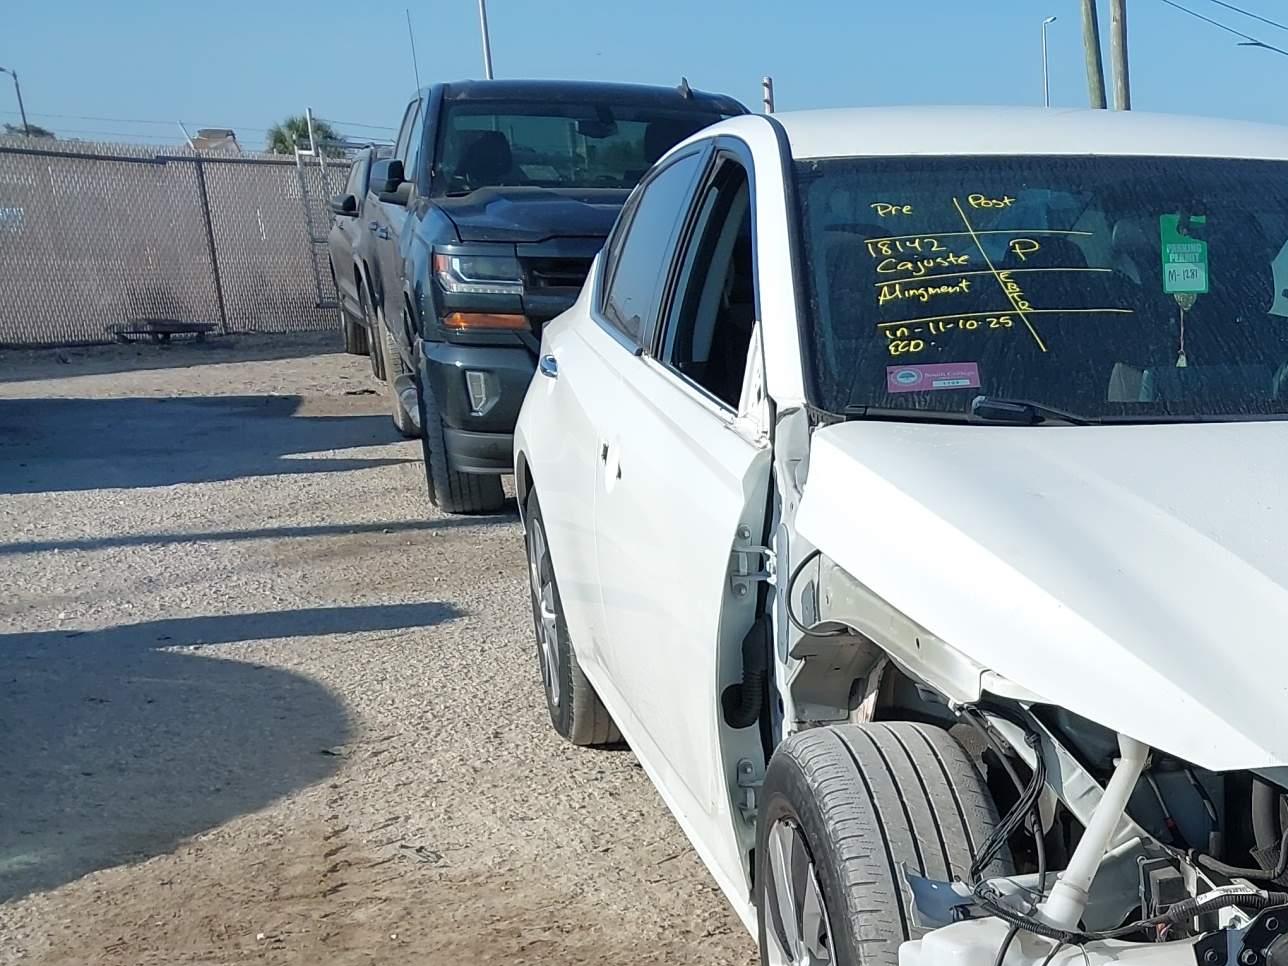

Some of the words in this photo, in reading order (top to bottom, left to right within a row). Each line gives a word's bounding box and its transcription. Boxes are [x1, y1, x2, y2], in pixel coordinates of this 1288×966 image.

[870, 202, 914, 218] Pre
[967, 193, 1017, 210] Post
[865, 237, 948, 258] 18142
[1008, 238, 1042, 261] P
[876, 252, 971, 276] Cajuste
[1169, 253, 1200, 263] PERMIT
